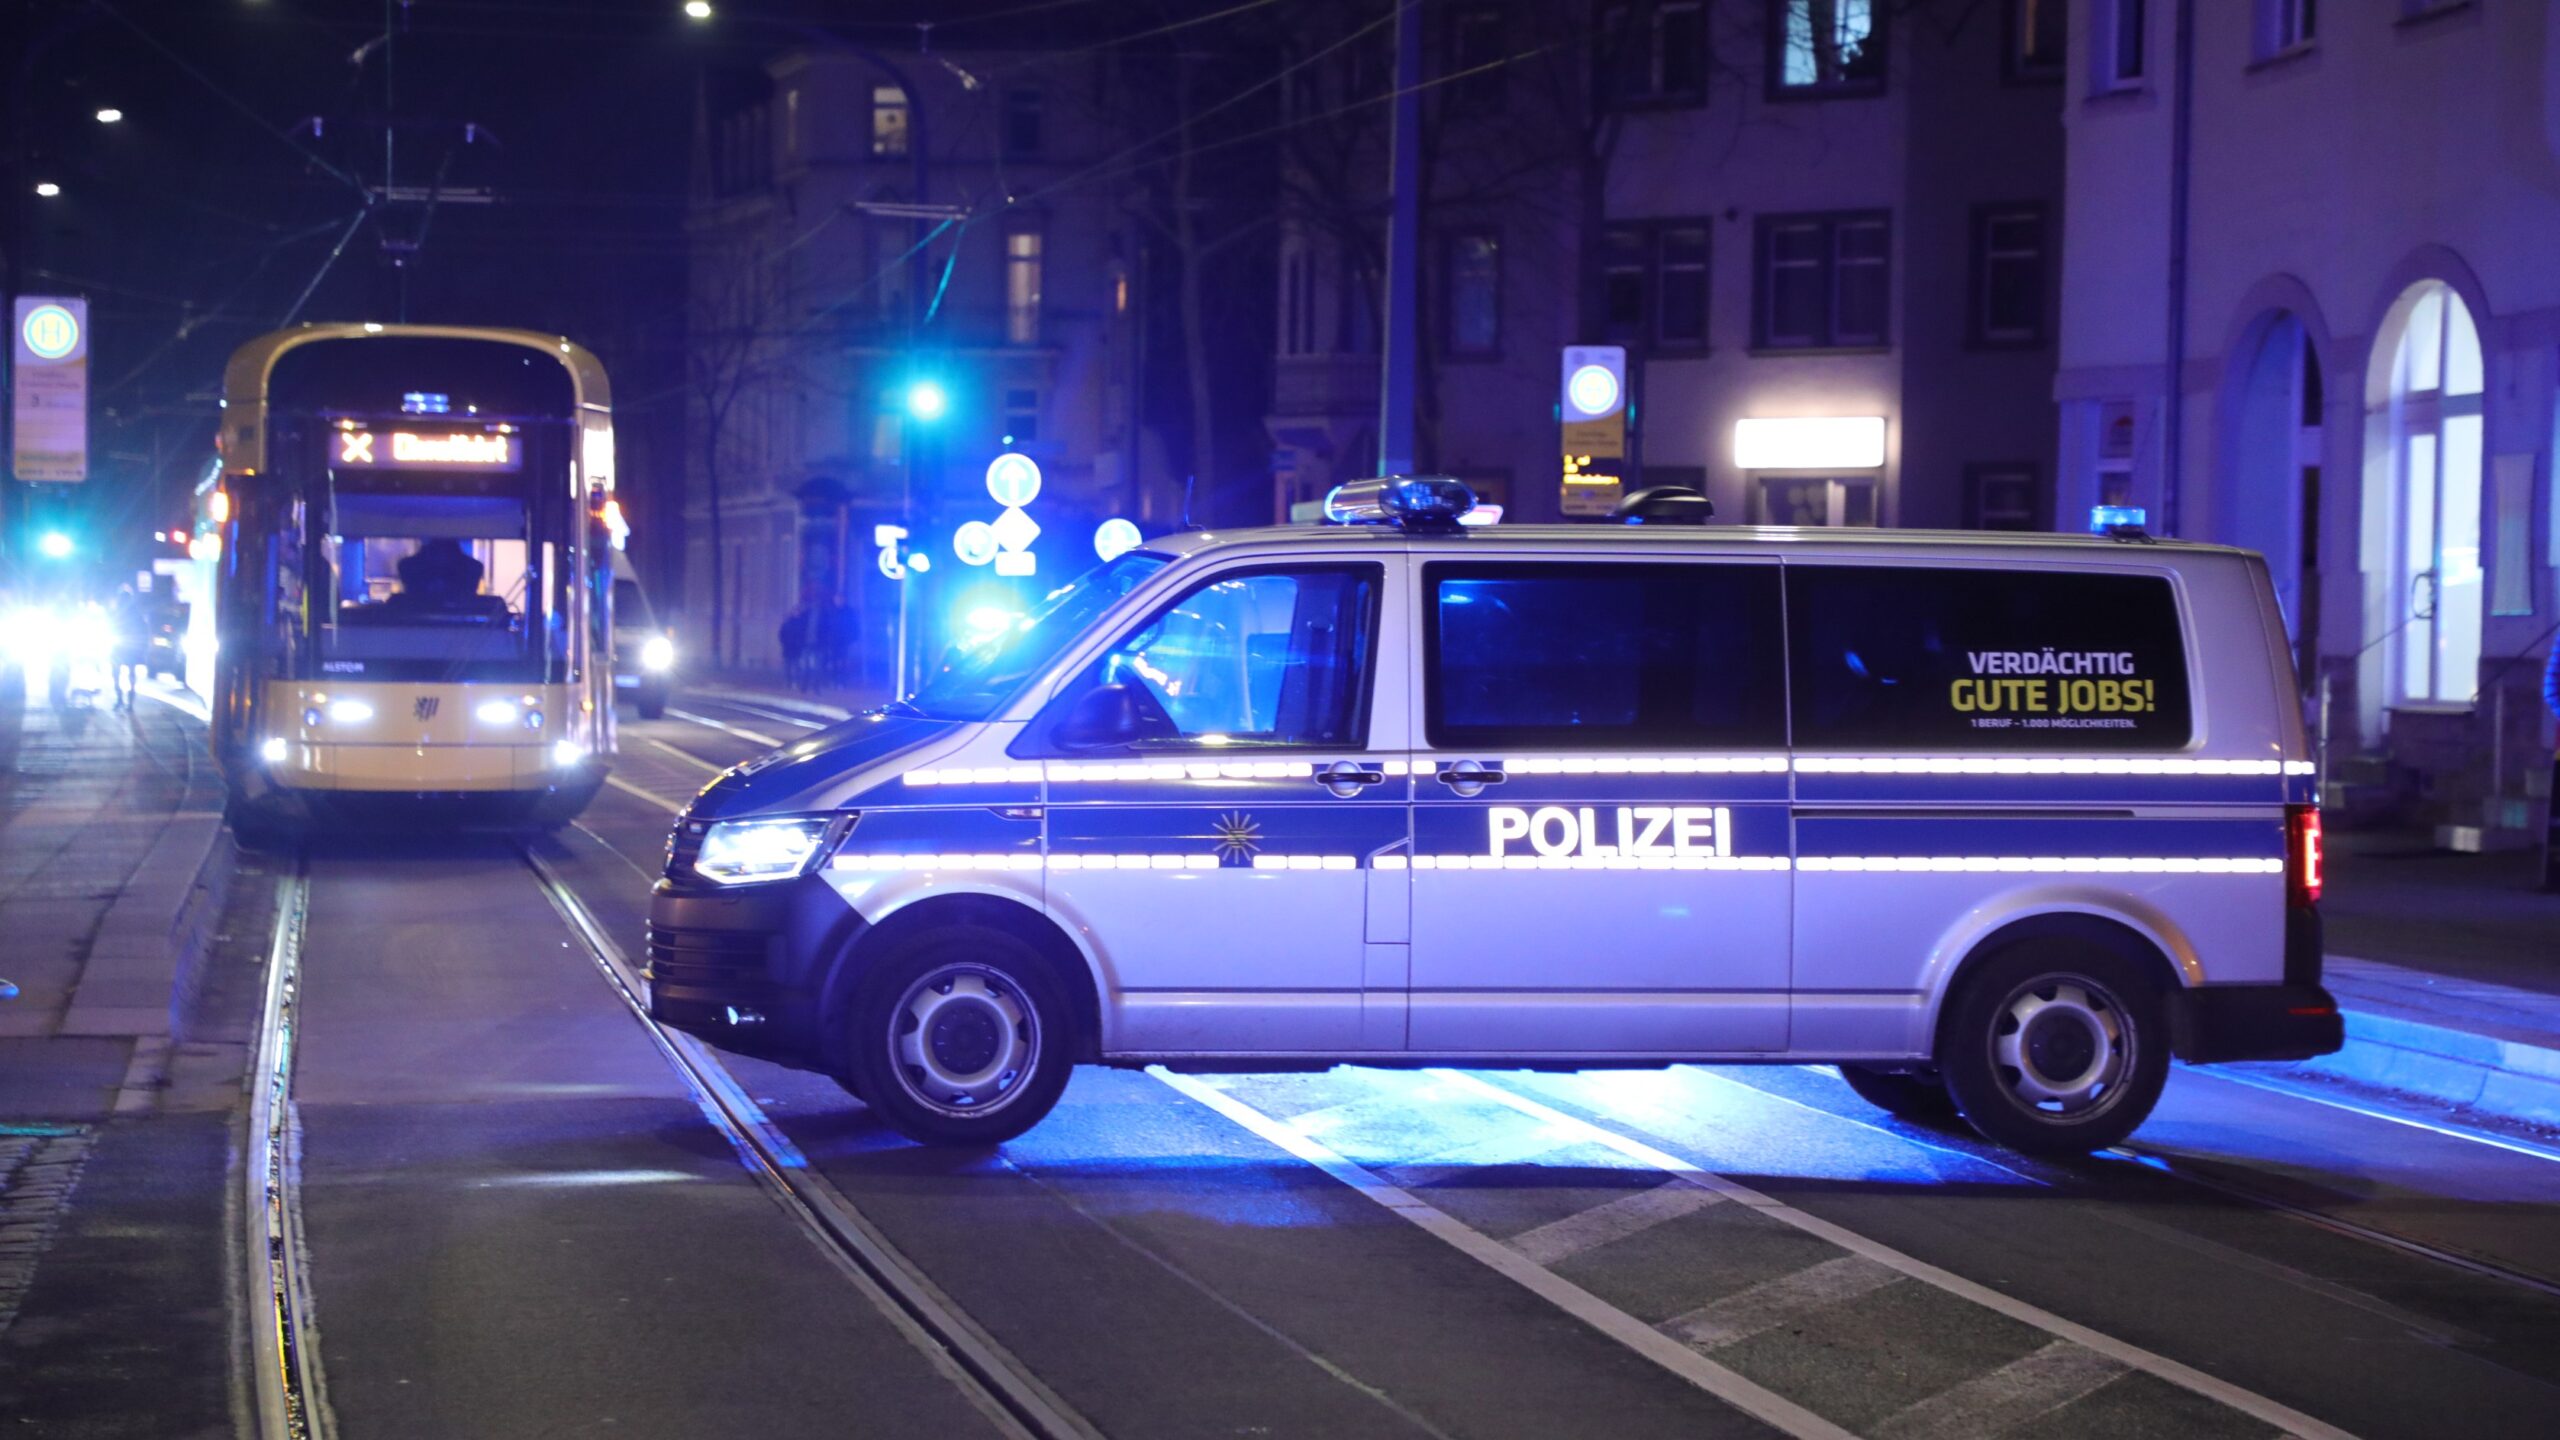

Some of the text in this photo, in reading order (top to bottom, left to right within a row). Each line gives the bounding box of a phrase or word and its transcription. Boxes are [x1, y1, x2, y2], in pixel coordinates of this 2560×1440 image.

[1968, 647, 2135, 674] VERDÄCHTIG
[1951, 679, 2155, 714] GUTE JOBS!
[1978, 718, 2012, 728] BERUF
[1488, 806, 1731, 857] POLIZEI
